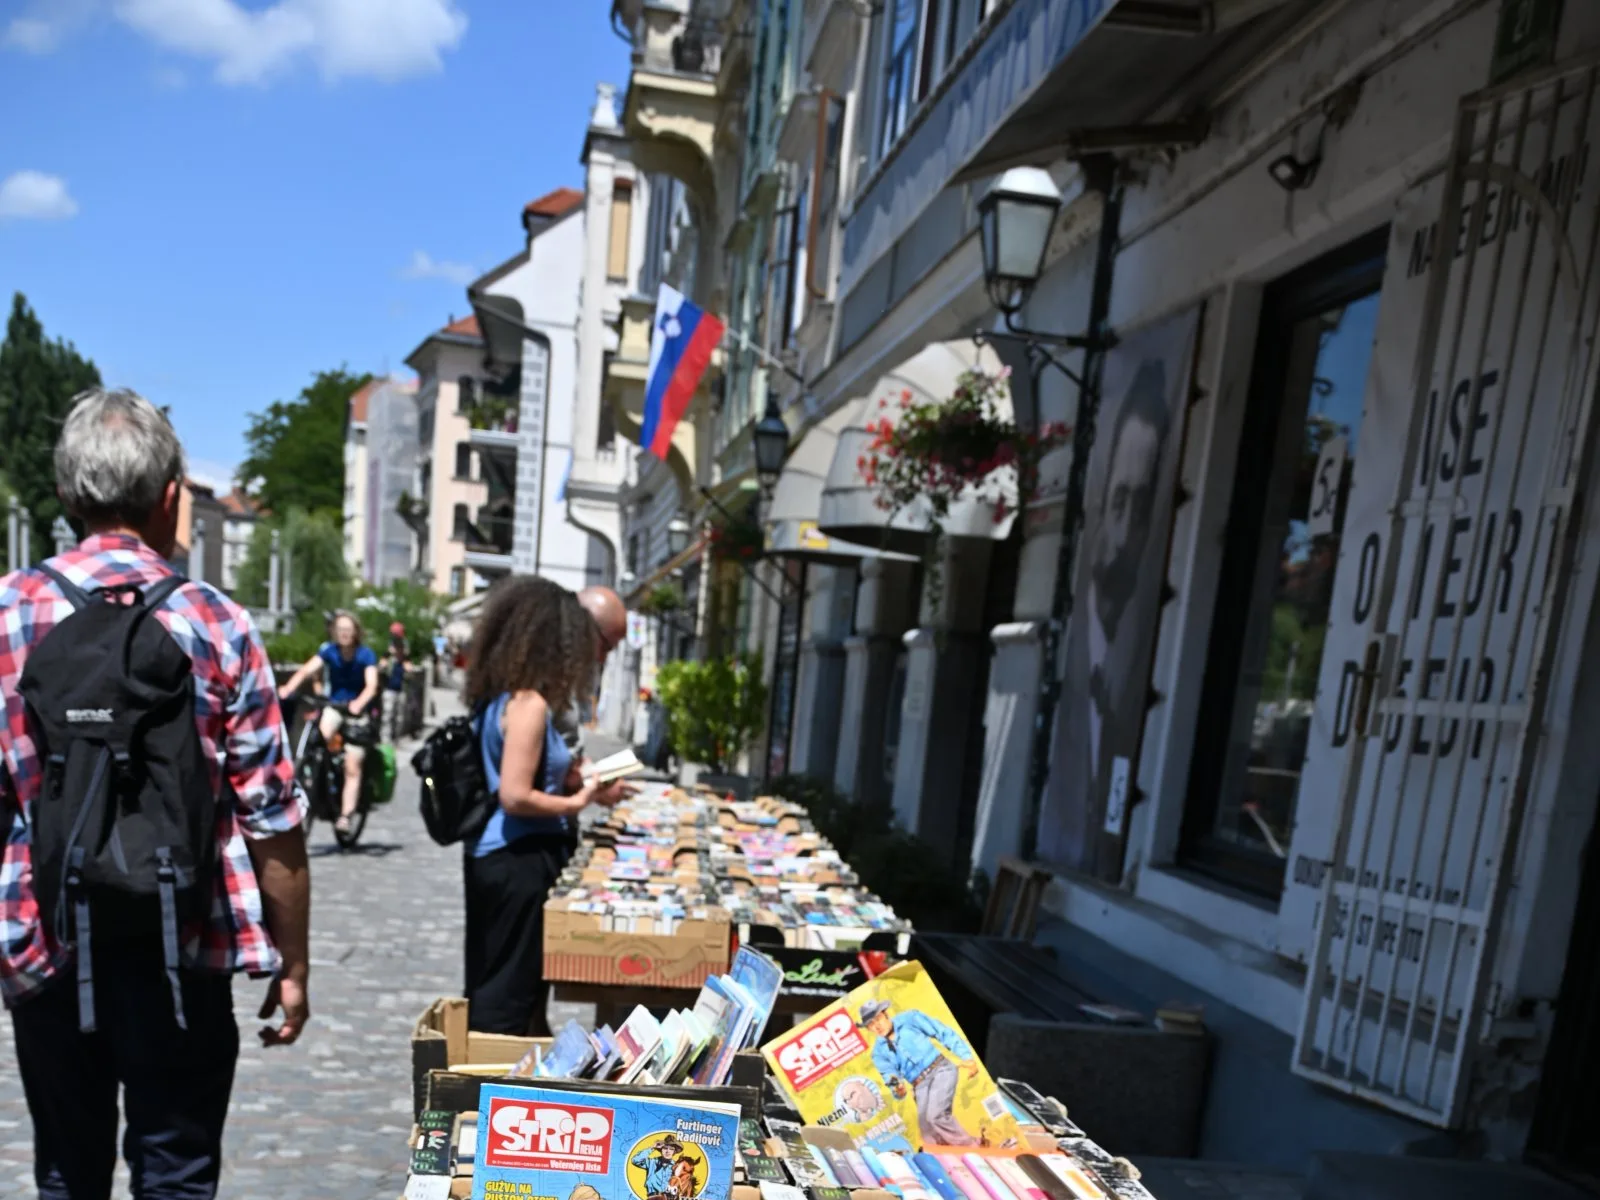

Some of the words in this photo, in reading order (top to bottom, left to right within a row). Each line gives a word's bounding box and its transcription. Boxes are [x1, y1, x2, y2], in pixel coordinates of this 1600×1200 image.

[676, 1119, 722, 1135] Furtinger
[676, 1131, 721, 1146] Radilović
[485, 1180, 516, 1194] GUŽVA
[519, 1183, 532, 1194] NA
